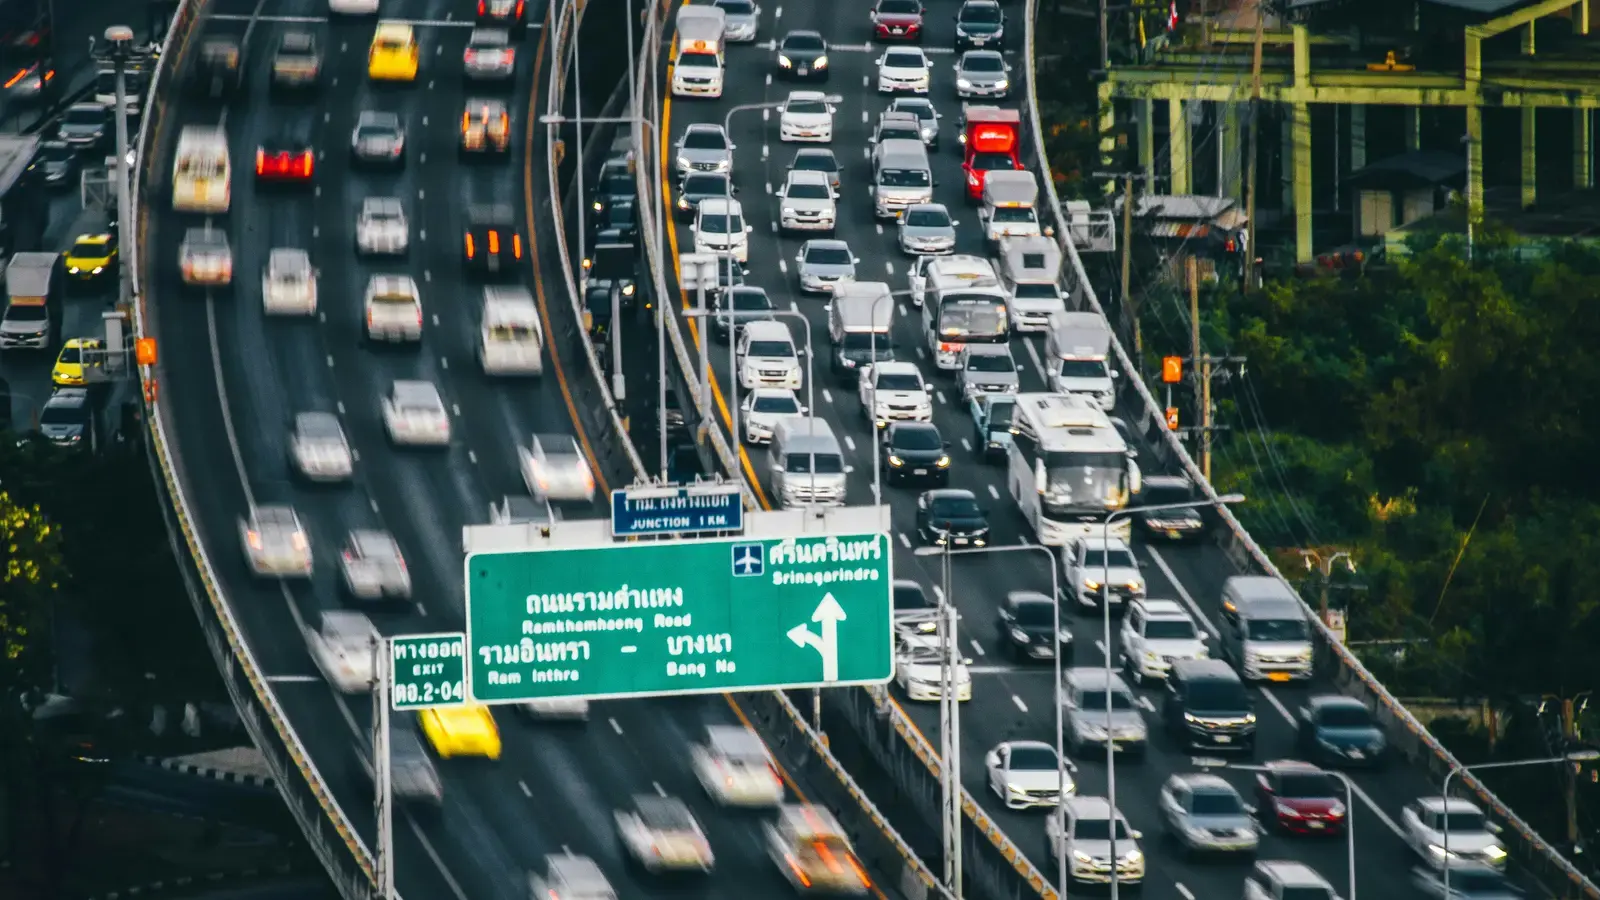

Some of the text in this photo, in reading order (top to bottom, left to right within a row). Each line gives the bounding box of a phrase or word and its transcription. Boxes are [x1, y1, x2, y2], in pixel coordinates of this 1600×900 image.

[630, 514, 728, 530] JUNCTION 1 KM.
[769, 533, 881, 565] ศรีนครินทร์
[772, 567, 879, 587] Srinagarindra
[526, 584, 684, 614] ถนนรามคำแหง
[522, 613, 692, 635] Ramkhamhaeng Road
[394, 641, 463, 660] ทางออก
[478, 637, 590, 665] รามอินทรา
[666, 633, 732, 656] บางนา
[412, 662, 444, 677] EXIT
[487, 668, 580, 685] Ram Inthra
[666, 658, 736, 678] Bang Na
